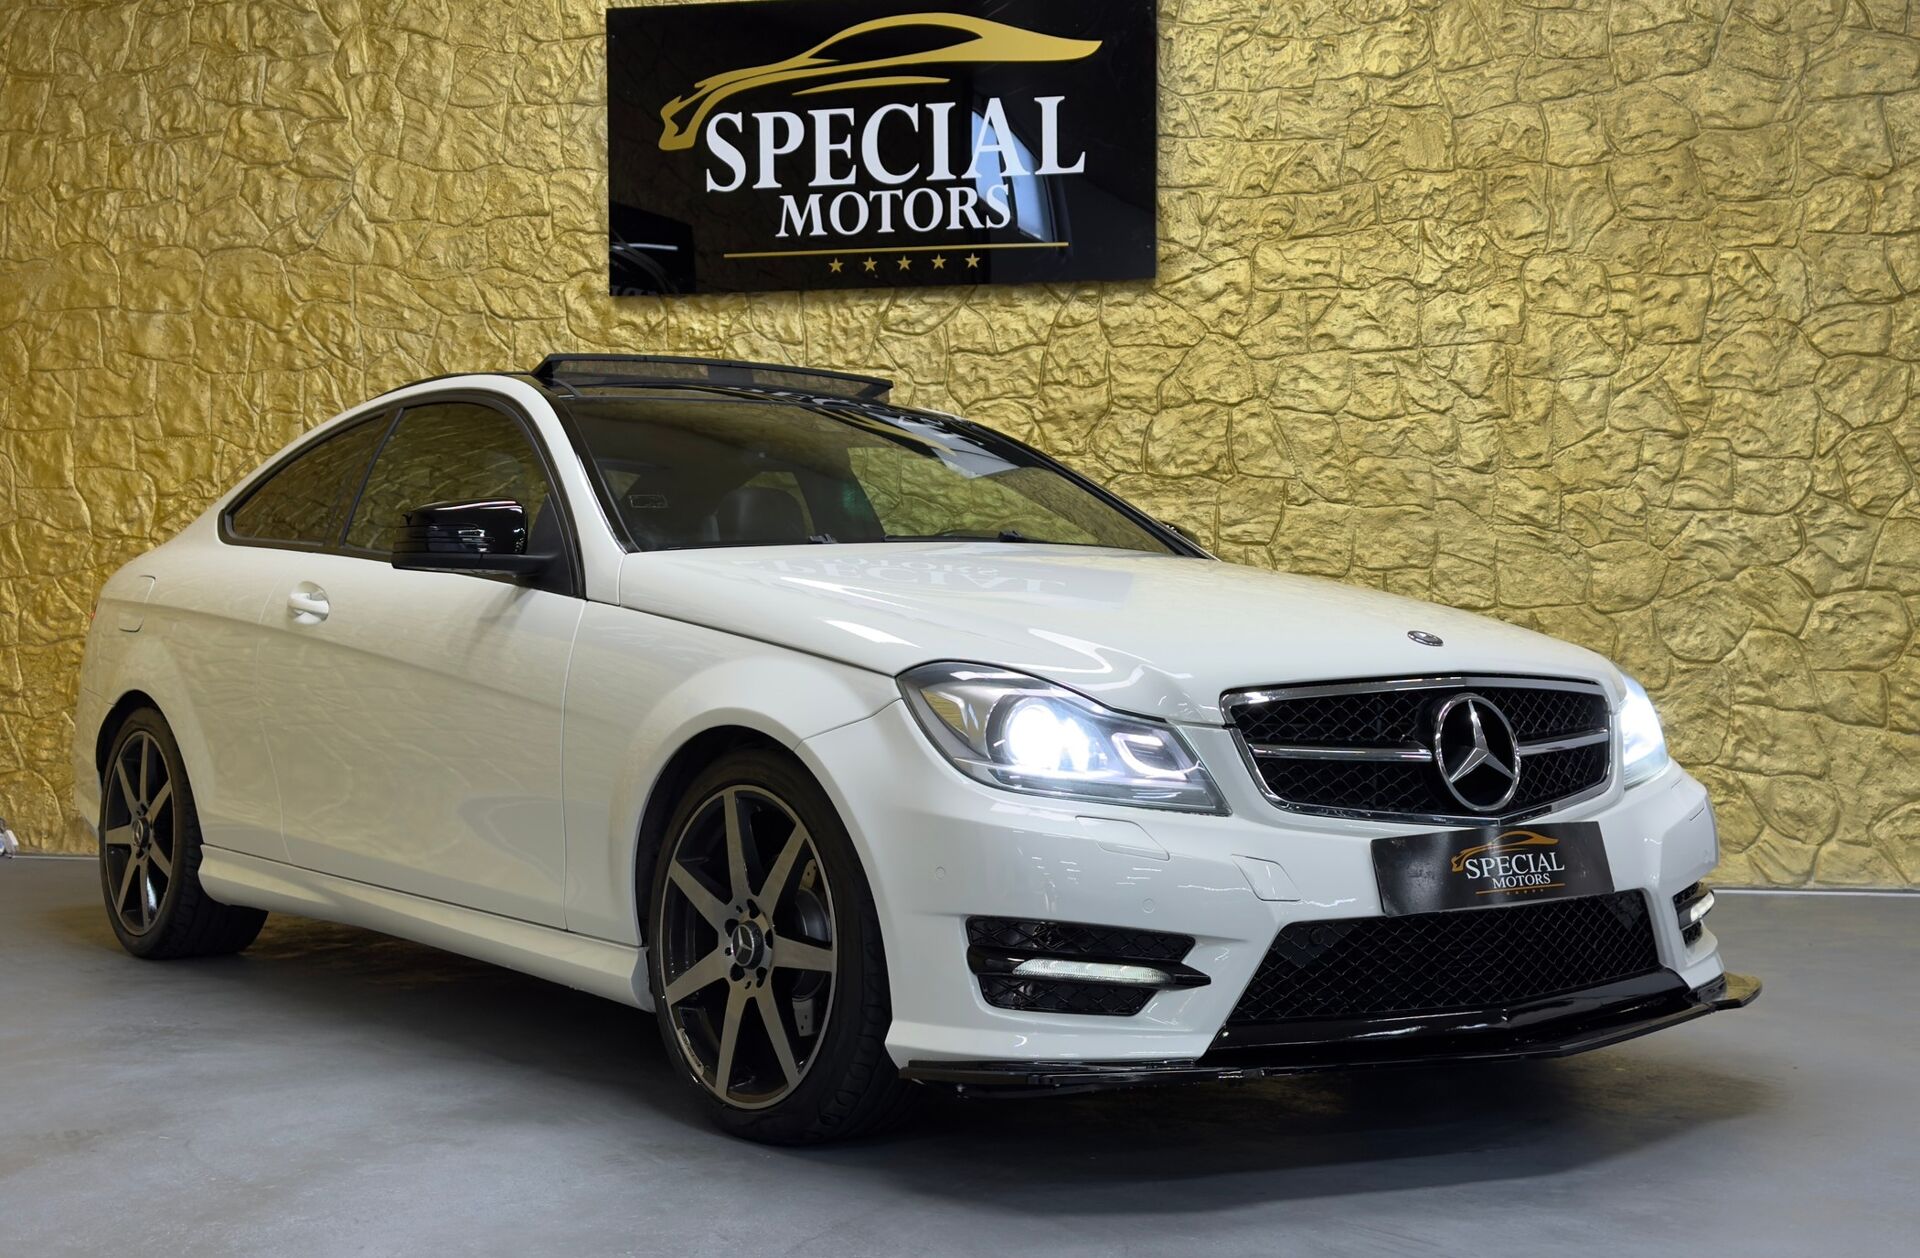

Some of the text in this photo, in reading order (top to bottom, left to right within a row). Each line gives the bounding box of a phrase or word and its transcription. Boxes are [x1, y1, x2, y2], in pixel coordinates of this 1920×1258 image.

[705, 96, 1085, 193] SPECIAL
[777, 185, 1010, 238] MOTORS
[1466, 853, 1565, 880] SPECIAL
[1492, 874, 1551, 889] MOTORS
